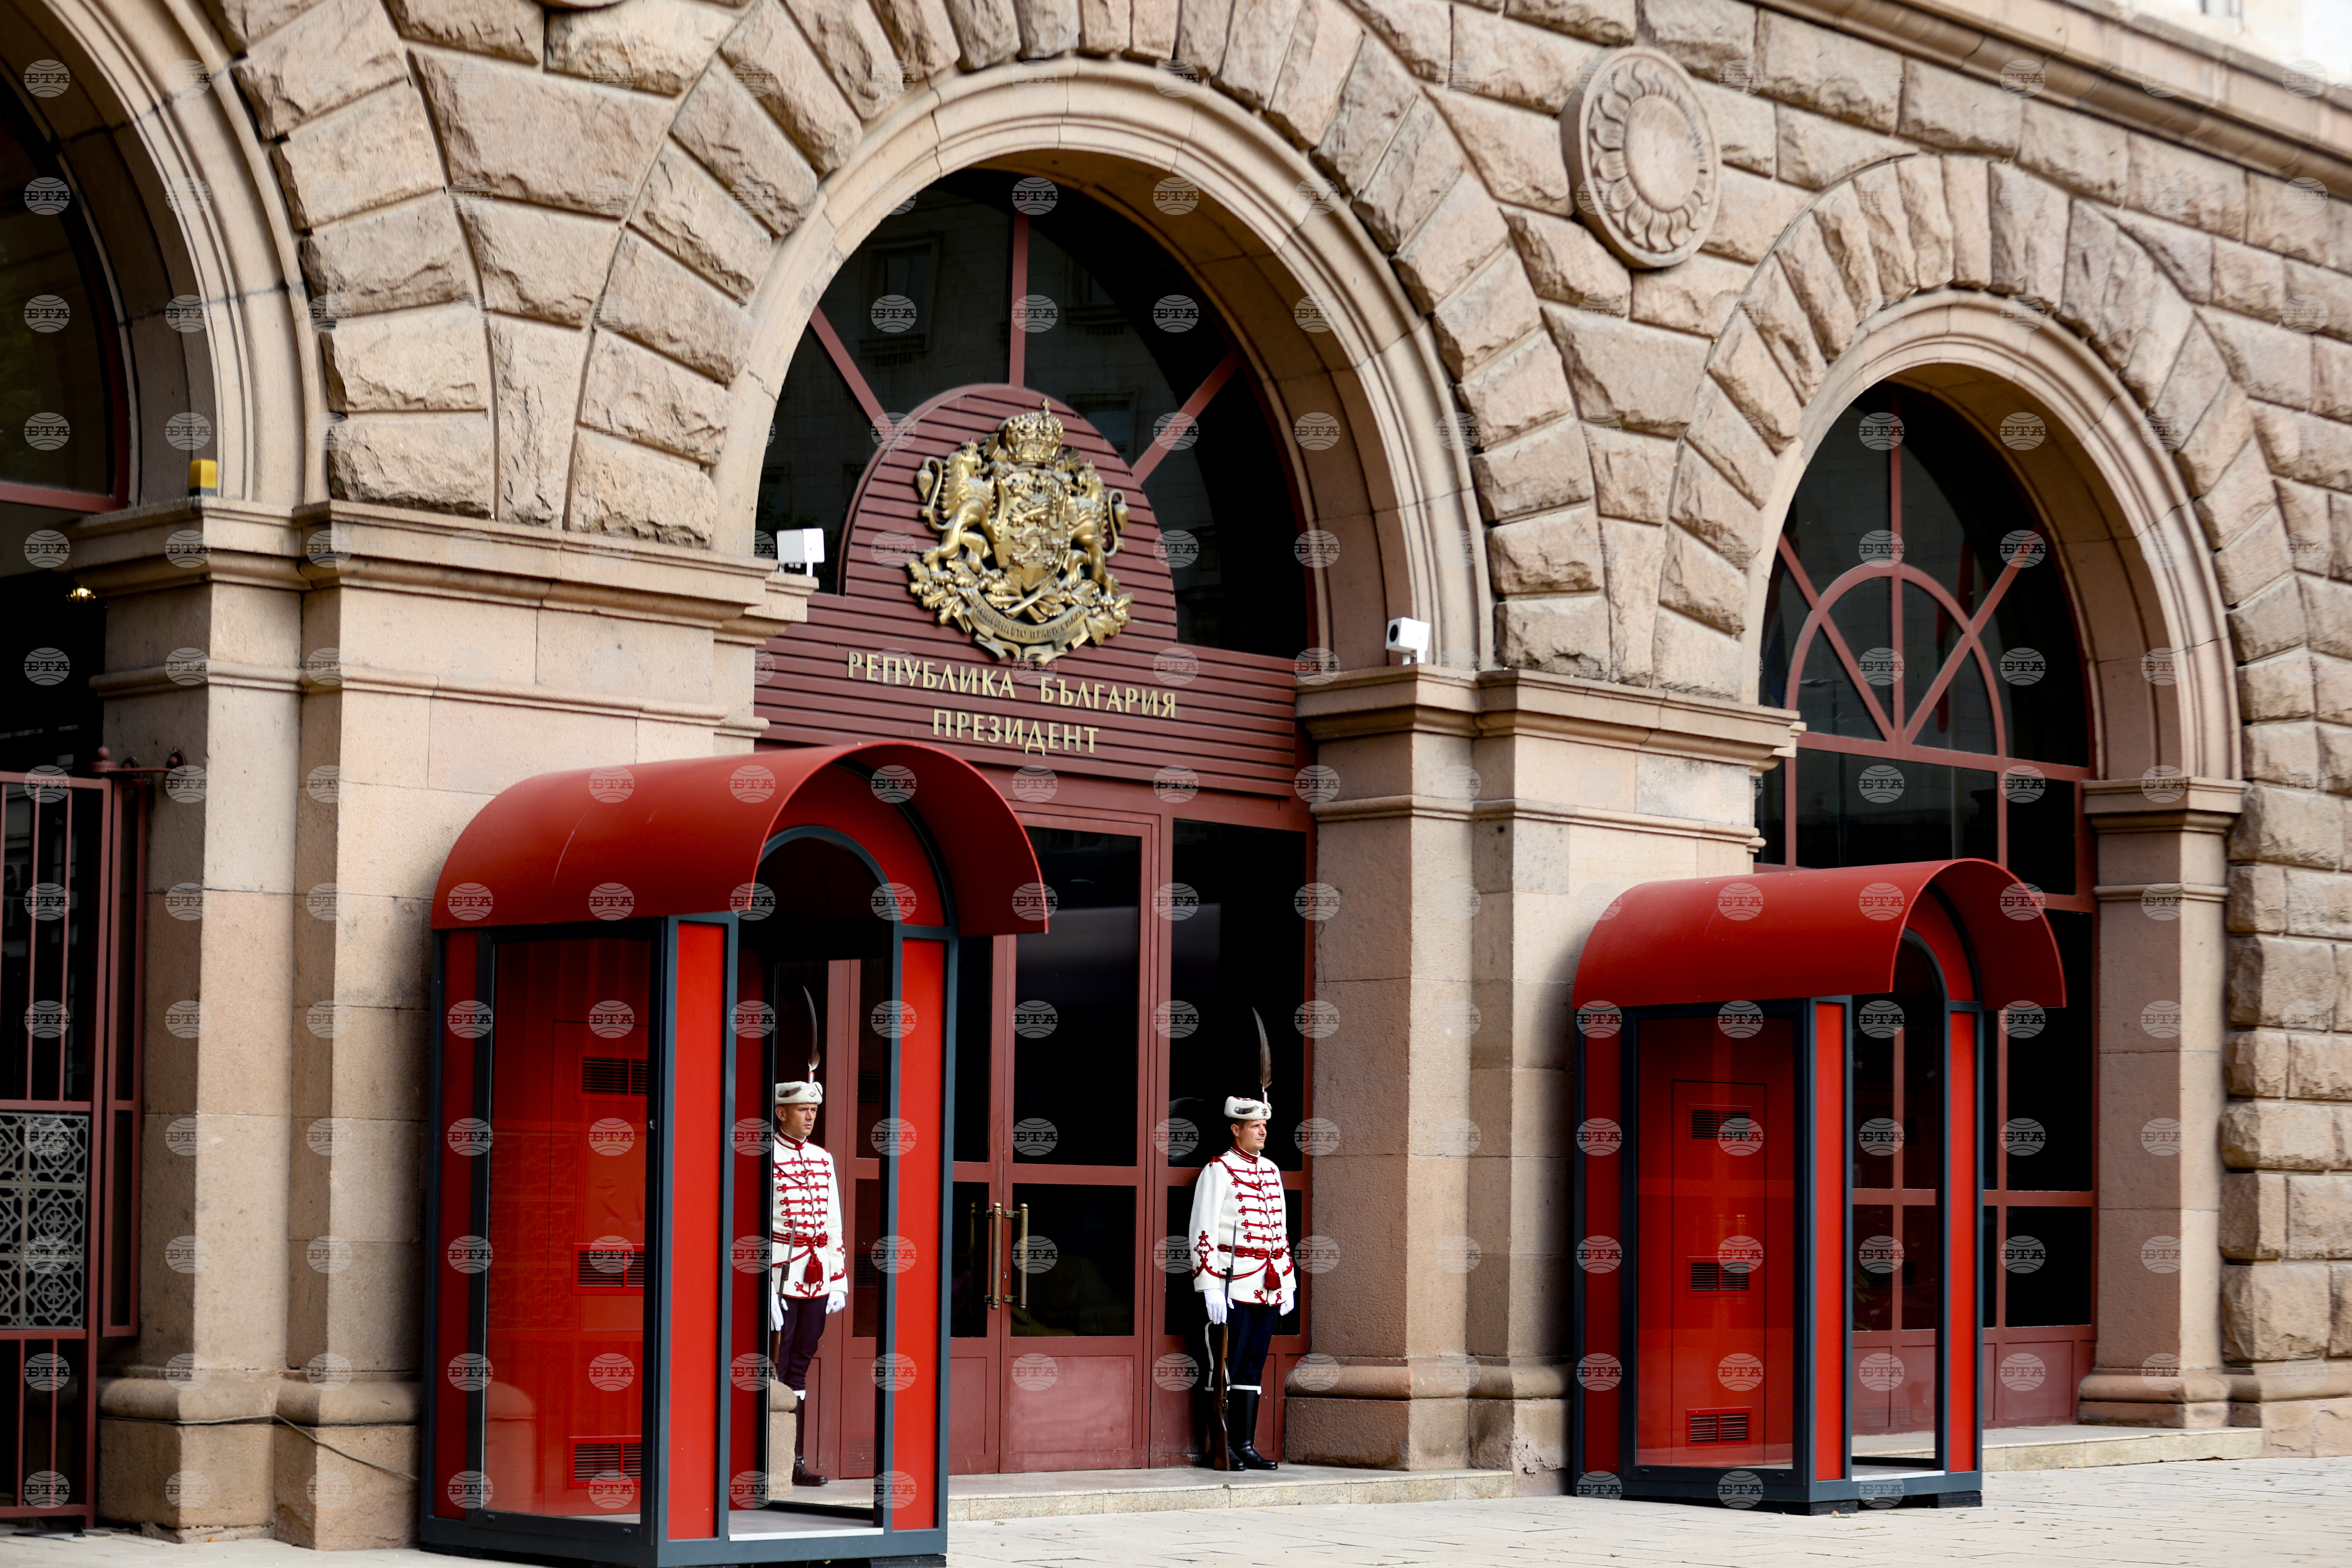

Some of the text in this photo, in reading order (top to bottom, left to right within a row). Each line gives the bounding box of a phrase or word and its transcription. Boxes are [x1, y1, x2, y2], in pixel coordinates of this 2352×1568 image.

[848, 651, 1176, 719] РЕПУБЛИКА БЪЛГАРИЯ
[933, 709, 1099, 756] ПРЕЗИДЕНТ
